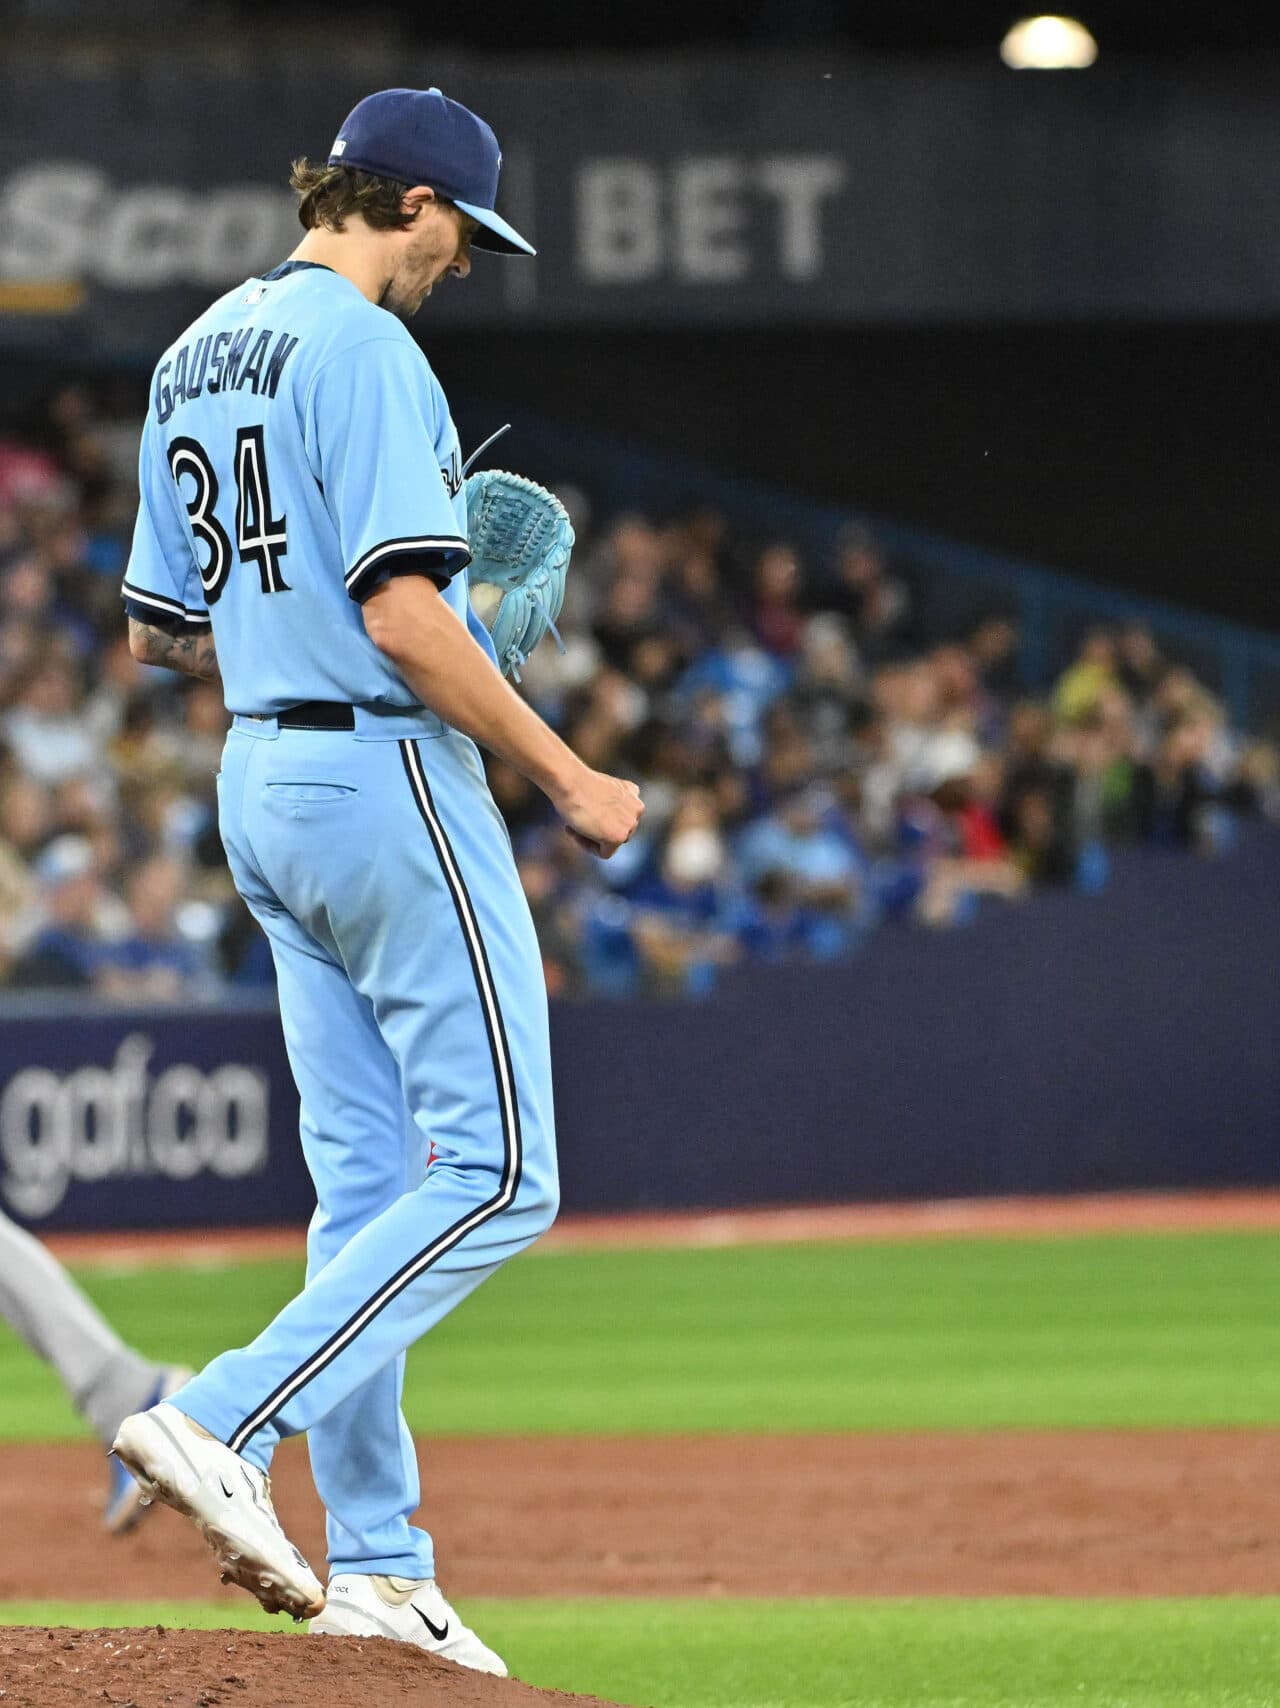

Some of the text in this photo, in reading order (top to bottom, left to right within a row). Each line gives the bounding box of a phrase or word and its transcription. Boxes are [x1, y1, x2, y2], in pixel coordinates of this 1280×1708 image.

[578, 156, 843, 282] BET
[155, 328, 299, 424] GAUSMAN
[168, 425, 291, 606] 34
